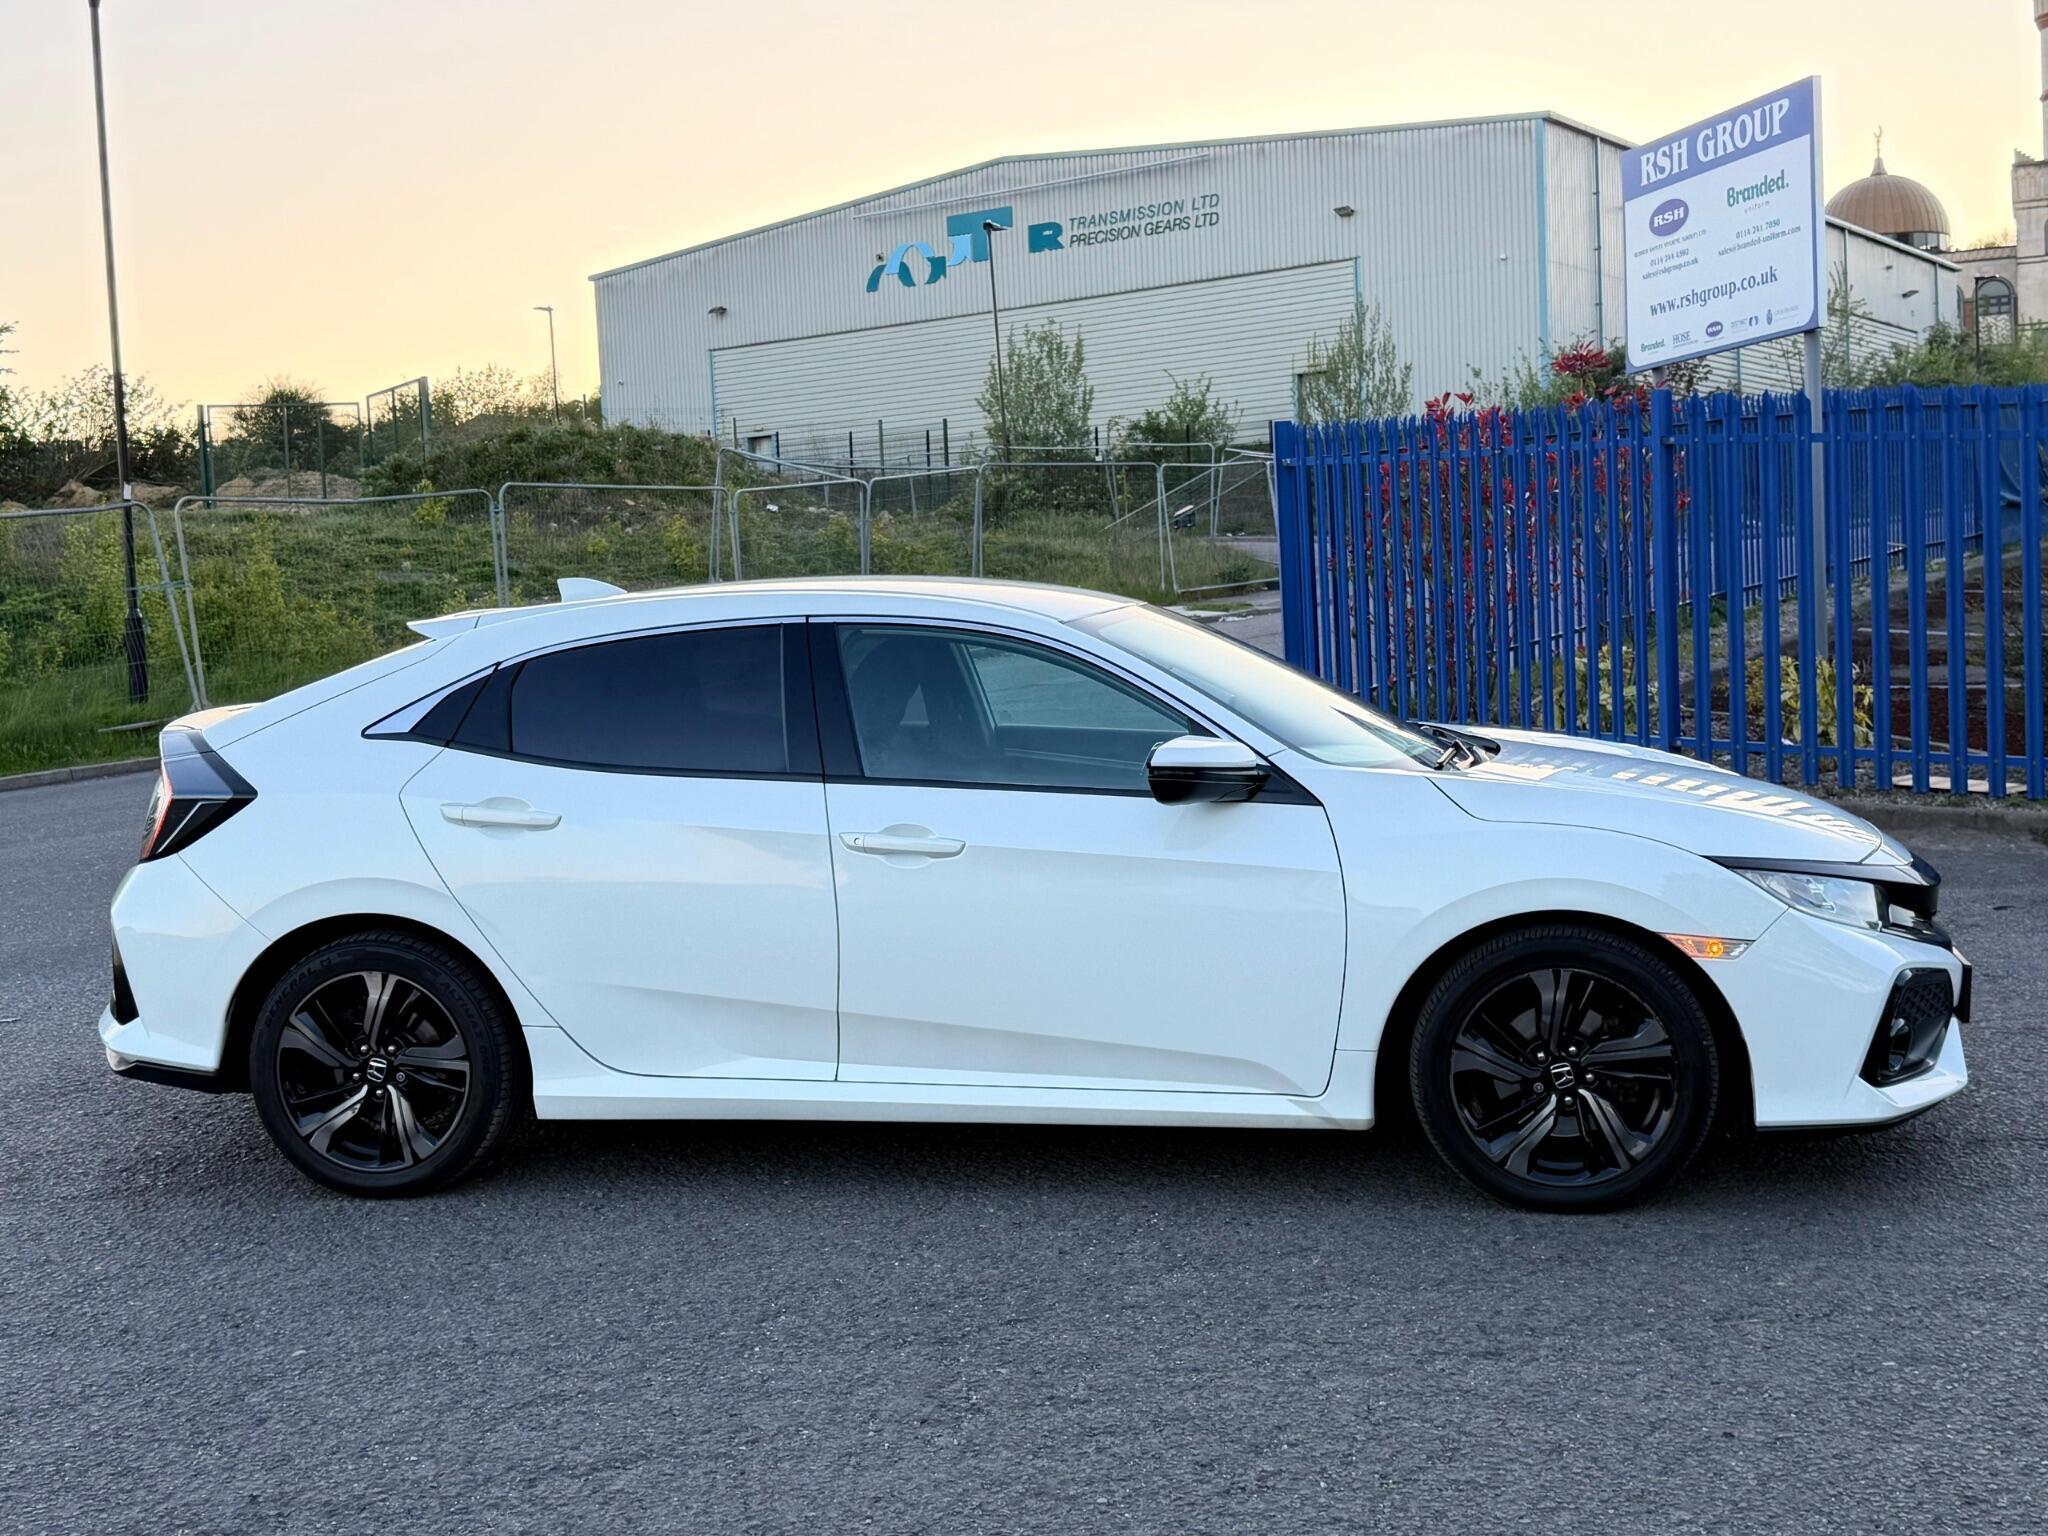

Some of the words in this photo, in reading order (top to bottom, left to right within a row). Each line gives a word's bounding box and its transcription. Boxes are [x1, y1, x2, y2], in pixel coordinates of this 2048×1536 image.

[1640, 138, 1688, 187] RSH
[1696, 98, 1790, 163] GROUP
[1726, 169, 1789, 208] Branded.
[1069, 199, 1184, 232] TRANSMISSION
[1191, 193, 1220, 211] LTD
[1069, 224, 1141, 248] PRECISION
[1144, 216, 1191, 237] GEARS
[1194, 211, 1219, 228] LTD
[1653, 206, 1684, 228] RSH
[1649, 266, 1778, 317] www.rshgroup.co.uk
